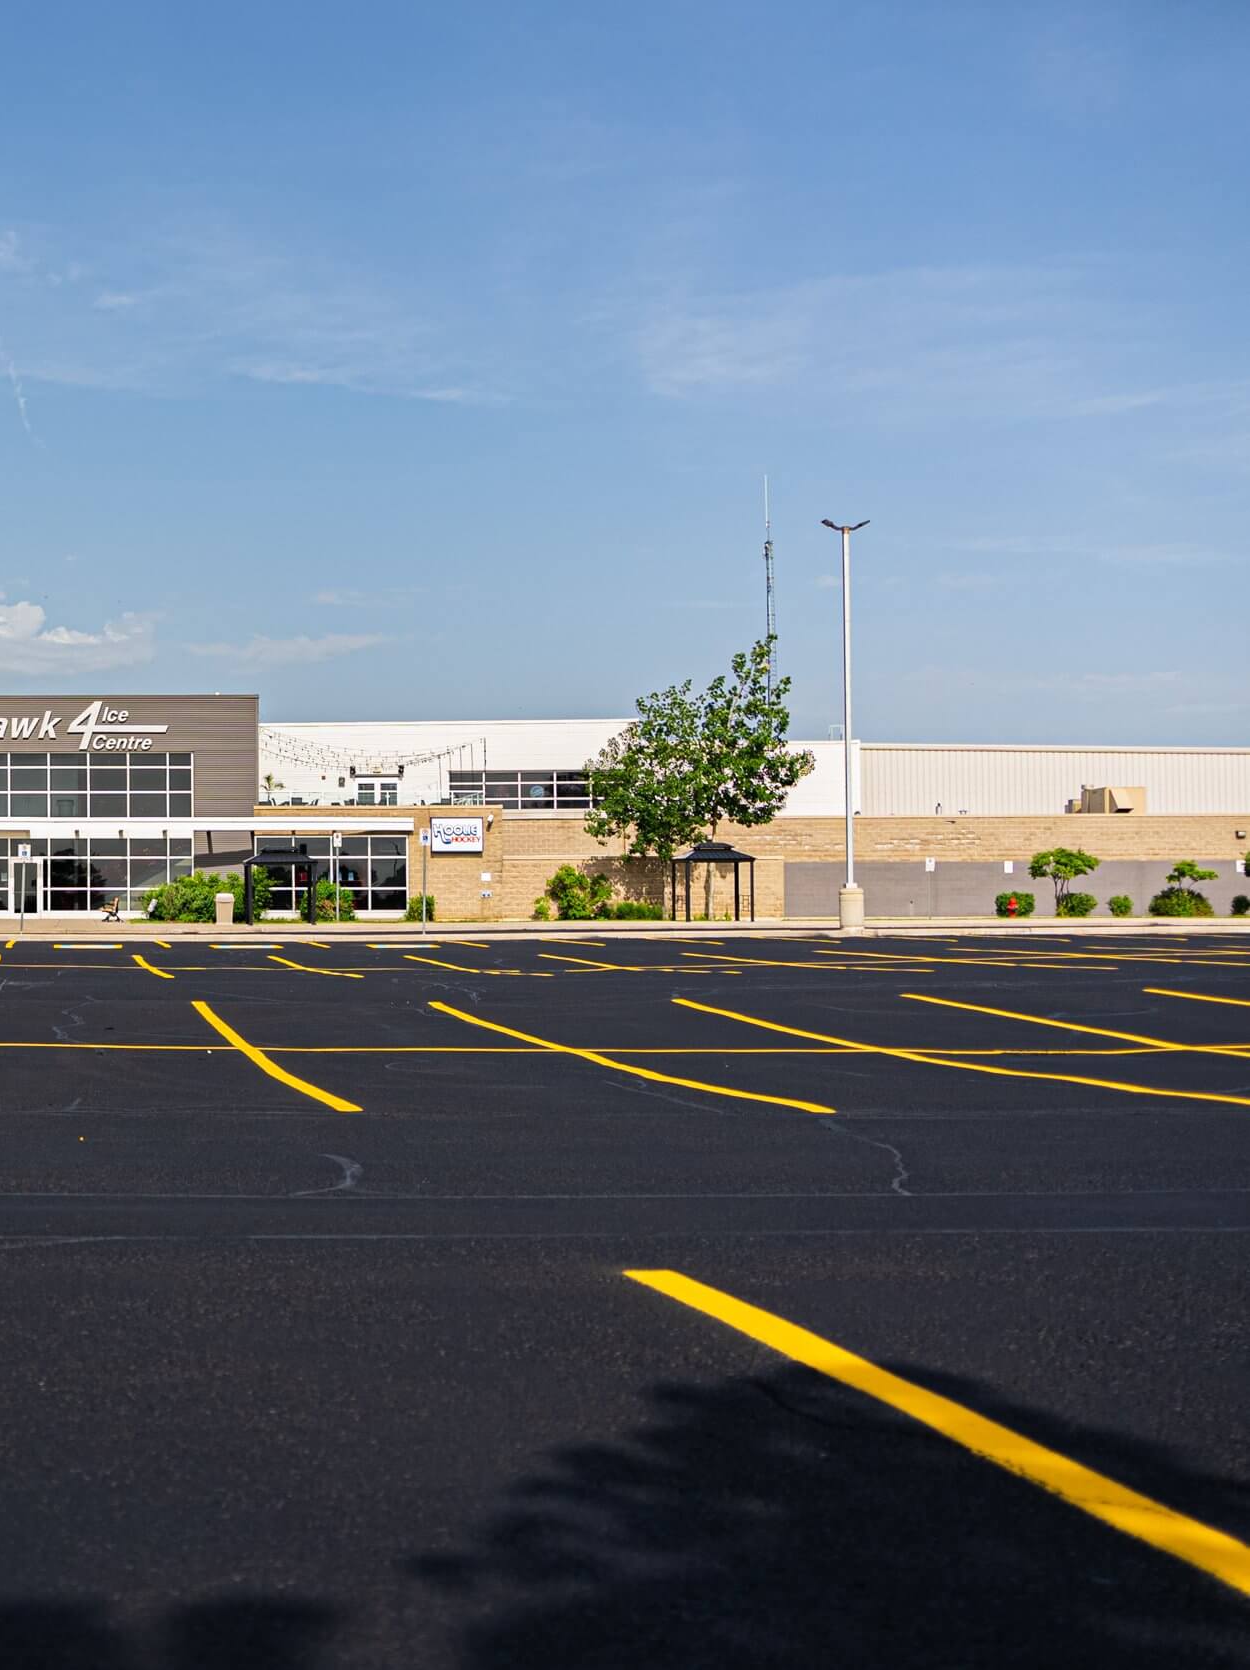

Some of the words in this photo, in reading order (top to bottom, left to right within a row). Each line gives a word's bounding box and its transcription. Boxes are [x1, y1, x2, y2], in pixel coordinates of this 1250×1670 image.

[101, 706, 129, 723] Ice
[67, 701, 103, 751] 4
[93, 734, 153, 751] Centre
